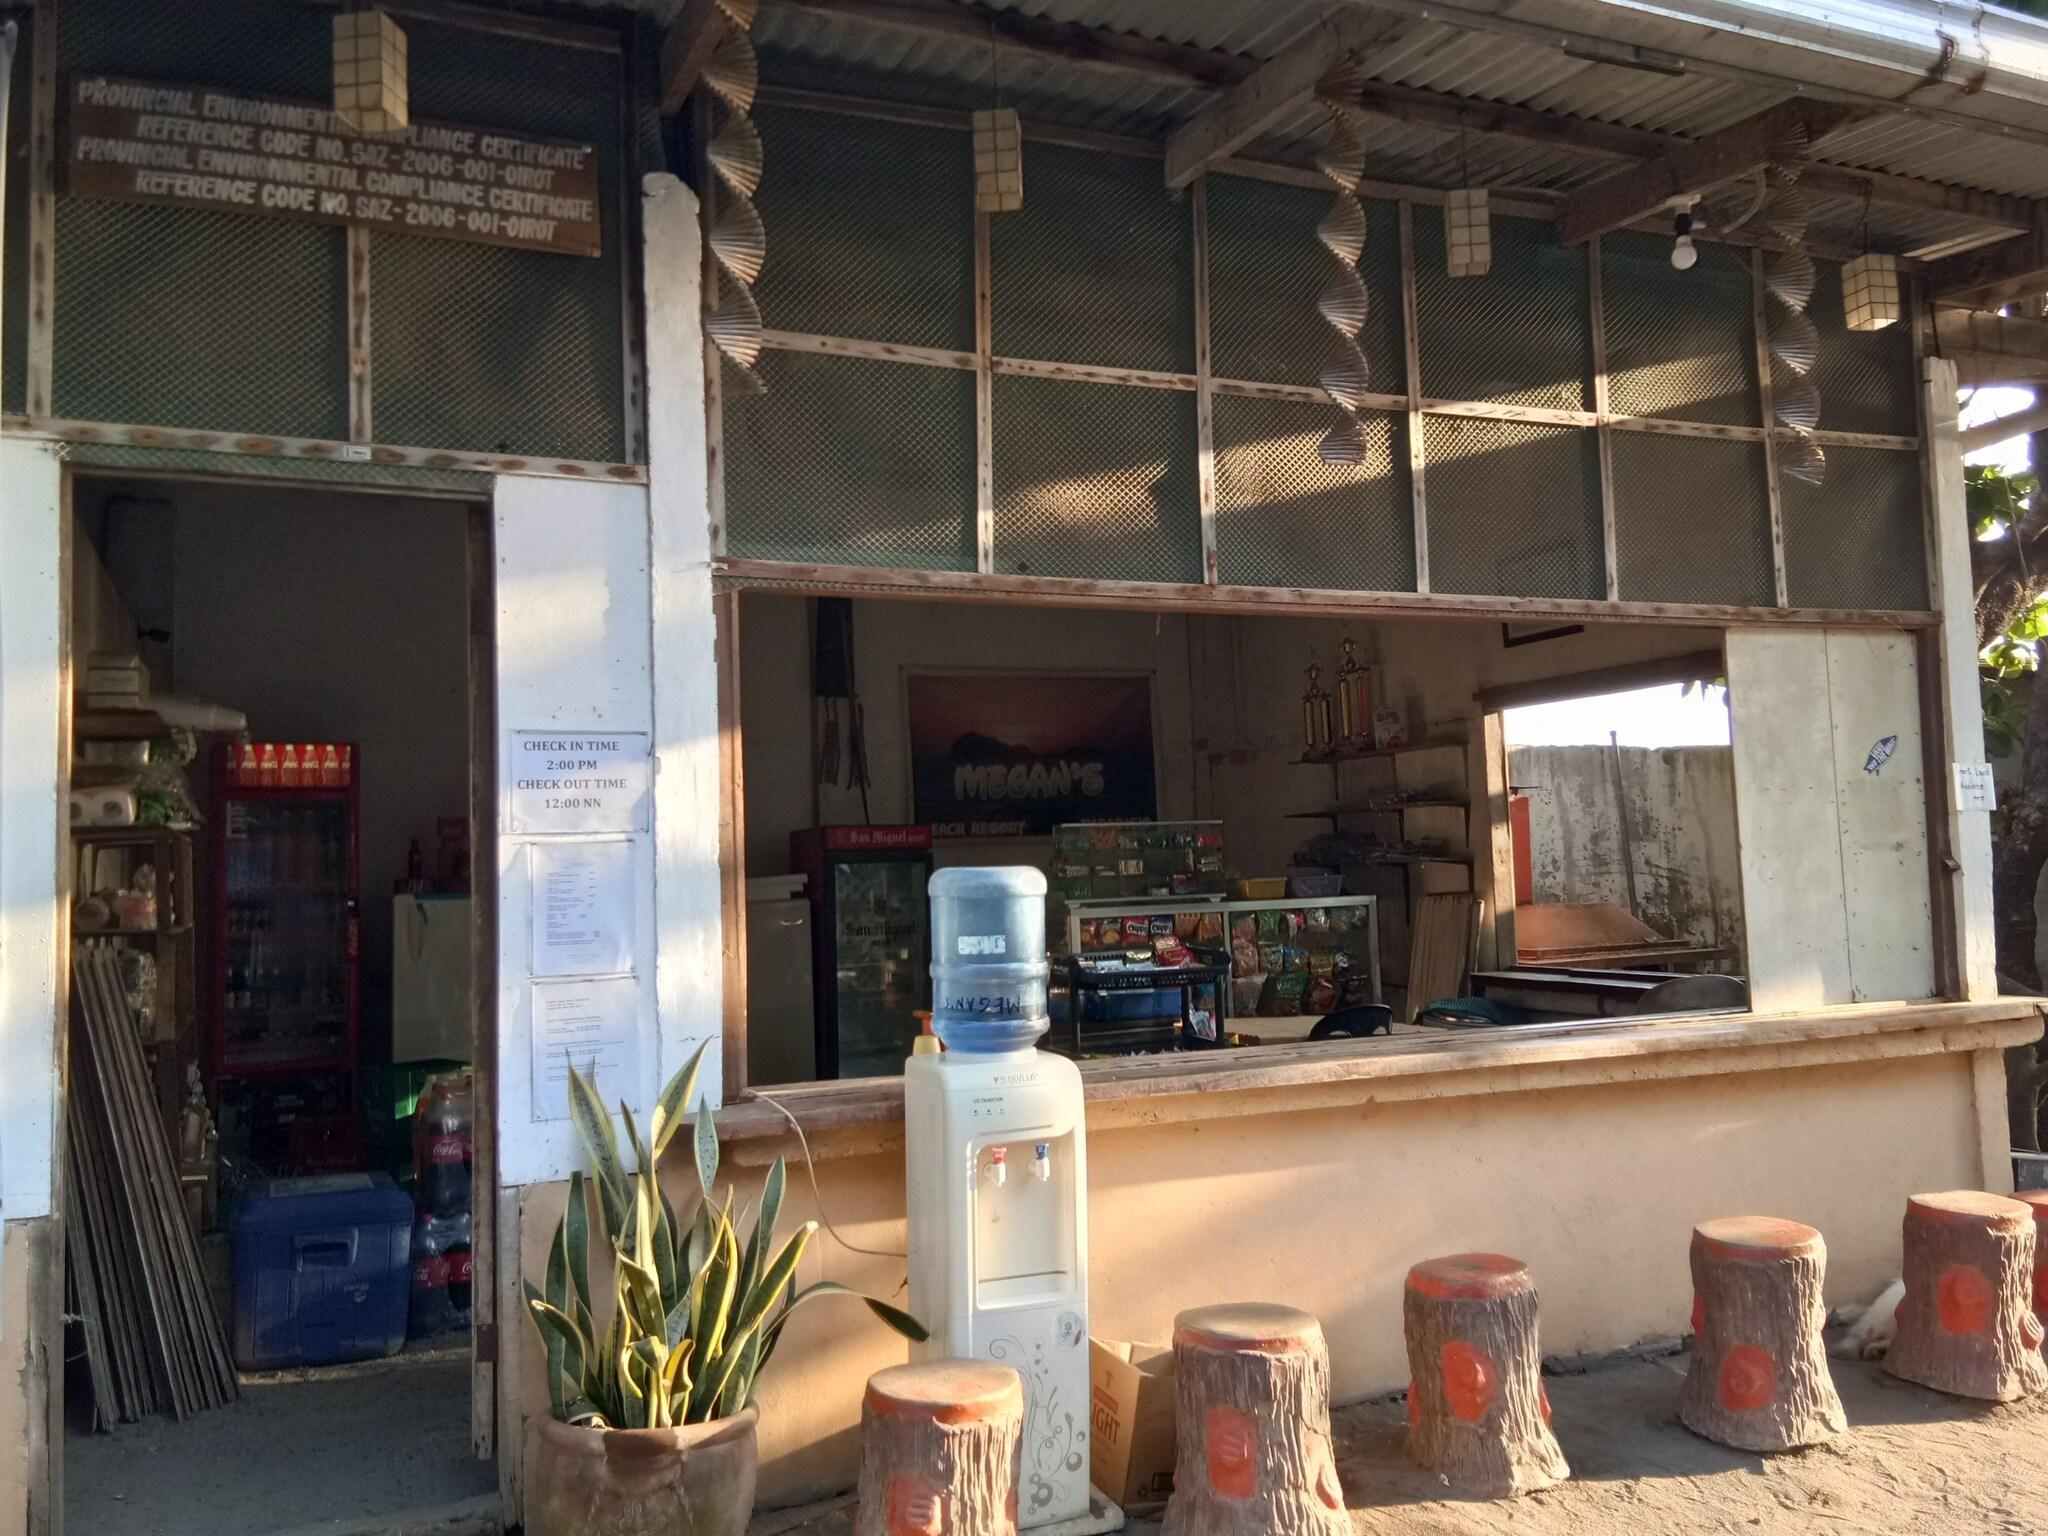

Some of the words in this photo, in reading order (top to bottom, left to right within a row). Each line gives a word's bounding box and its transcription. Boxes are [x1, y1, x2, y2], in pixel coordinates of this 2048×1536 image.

[79, 79, 197, 115] PROVINCIAL
[203, 94, 358, 138] ENVIRONMENT
[481, 136, 585, 170] CERTIFICATE
[137, 114, 255, 149] REFERENCE
[260, 129, 311, 157] CODE
[316, 138, 348, 163] NO.
[77, 136, 193, 170] PROVINCIAL
[197, 149, 362, 190] ENVIRONMENTAL
[365, 171, 485, 207] COMPLIANCE
[489, 189, 593, 221] CERTIFICATE
[135, 169, 256, 204] REFERENCE
[261, 183, 315, 212] CODE
[320, 190, 352, 217] NO.
[523, 741, 567, 752] CHECK
[570, 741, 584, 751] IN
[586, 741, 620, 751] TIME
[546, 760, 575, 770] 2:00
[578, 760, 598, 770] PM
[954, 759, 1105, 801] MEGAN'S
[517, 779, 561, 790] CHECK
[563, 779, 591, 789] OUT
[593, 779, 627, 789] TIME
[544, 799, 580, 809] 12:00
[583, 798, 602, 808] NN
[932, 821, 966, 837] EACH
[945, 994, 1021, 1015] MEGAN'S
[1092, 1403, 1121, 1445] IGHT
